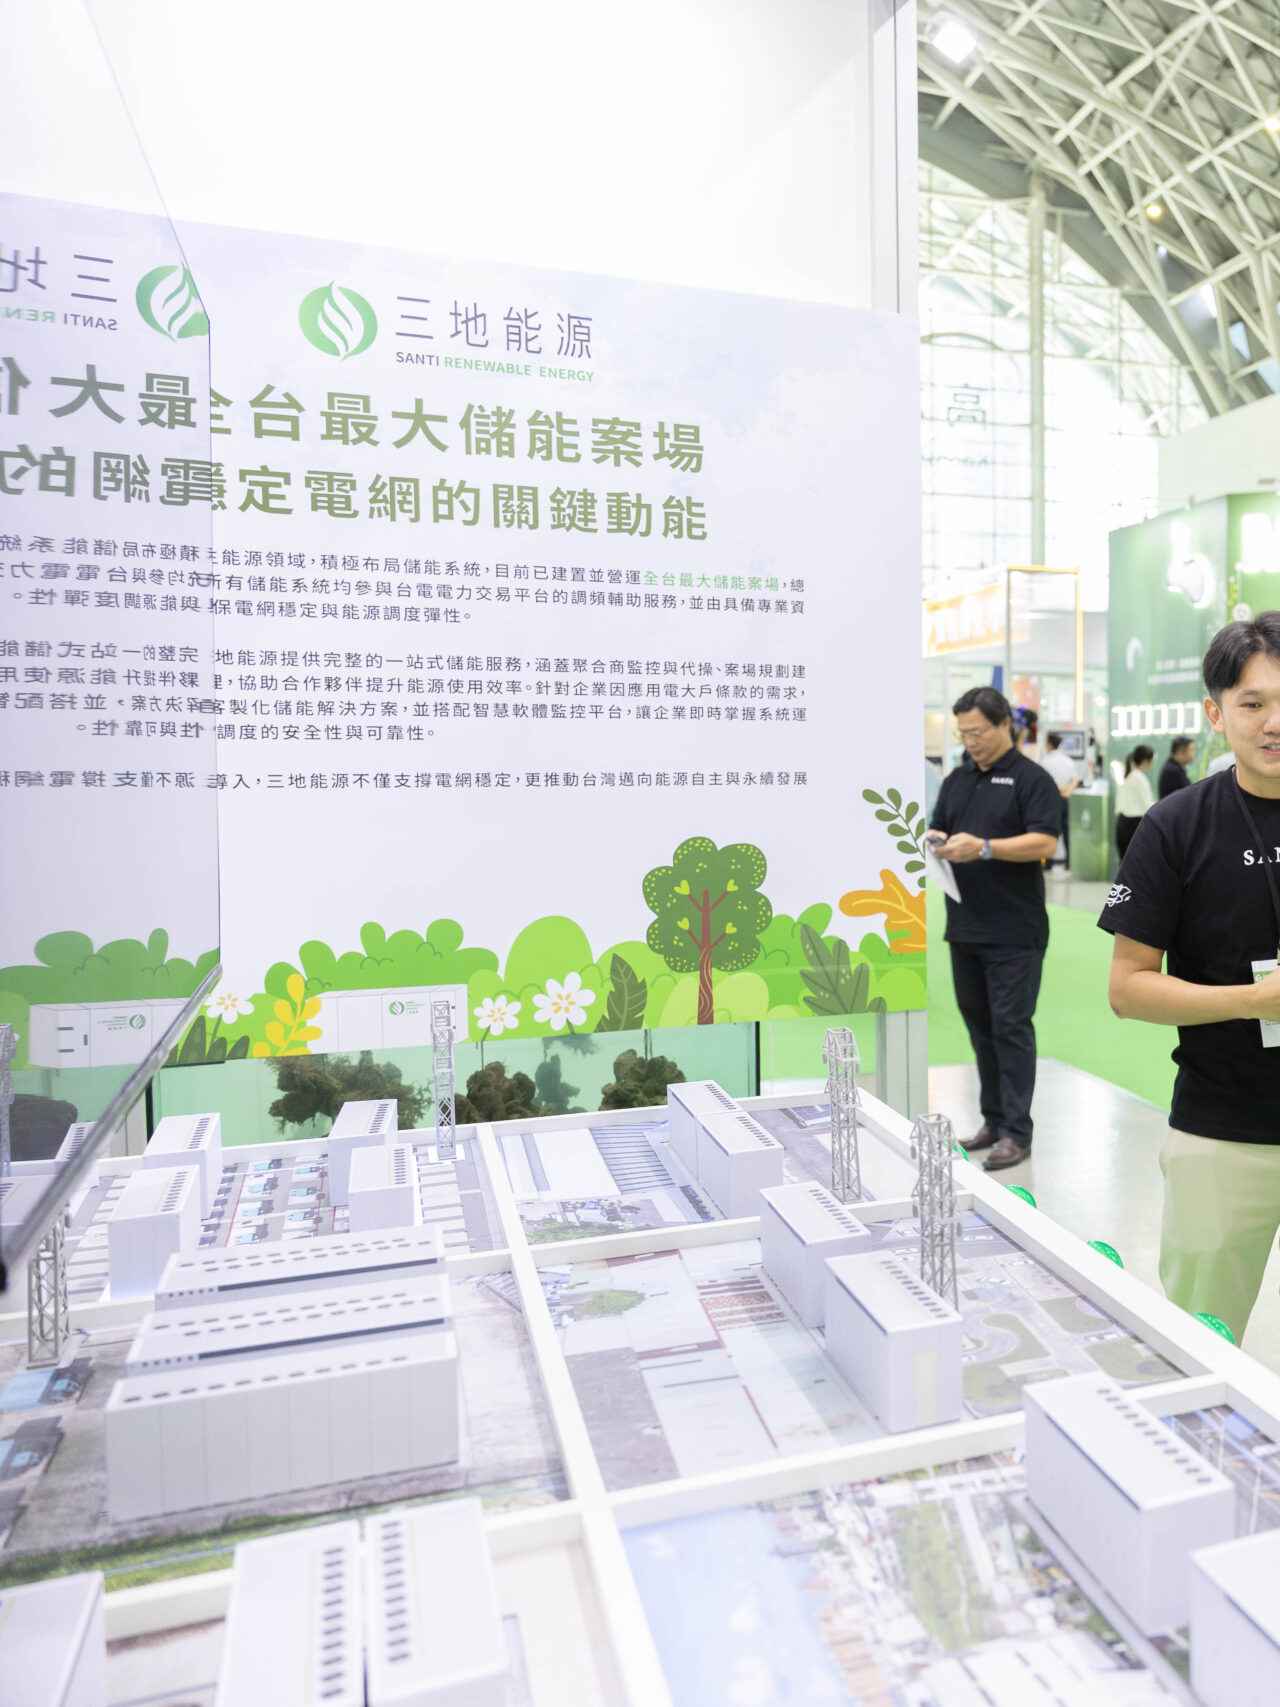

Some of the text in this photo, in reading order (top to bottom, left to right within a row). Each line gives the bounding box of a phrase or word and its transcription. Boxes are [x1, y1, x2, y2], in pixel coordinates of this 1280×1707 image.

[396, 296, 593, 360] 三地能源
[396, 351, 594, 382] SANTI RENEWABLE ENERGY
